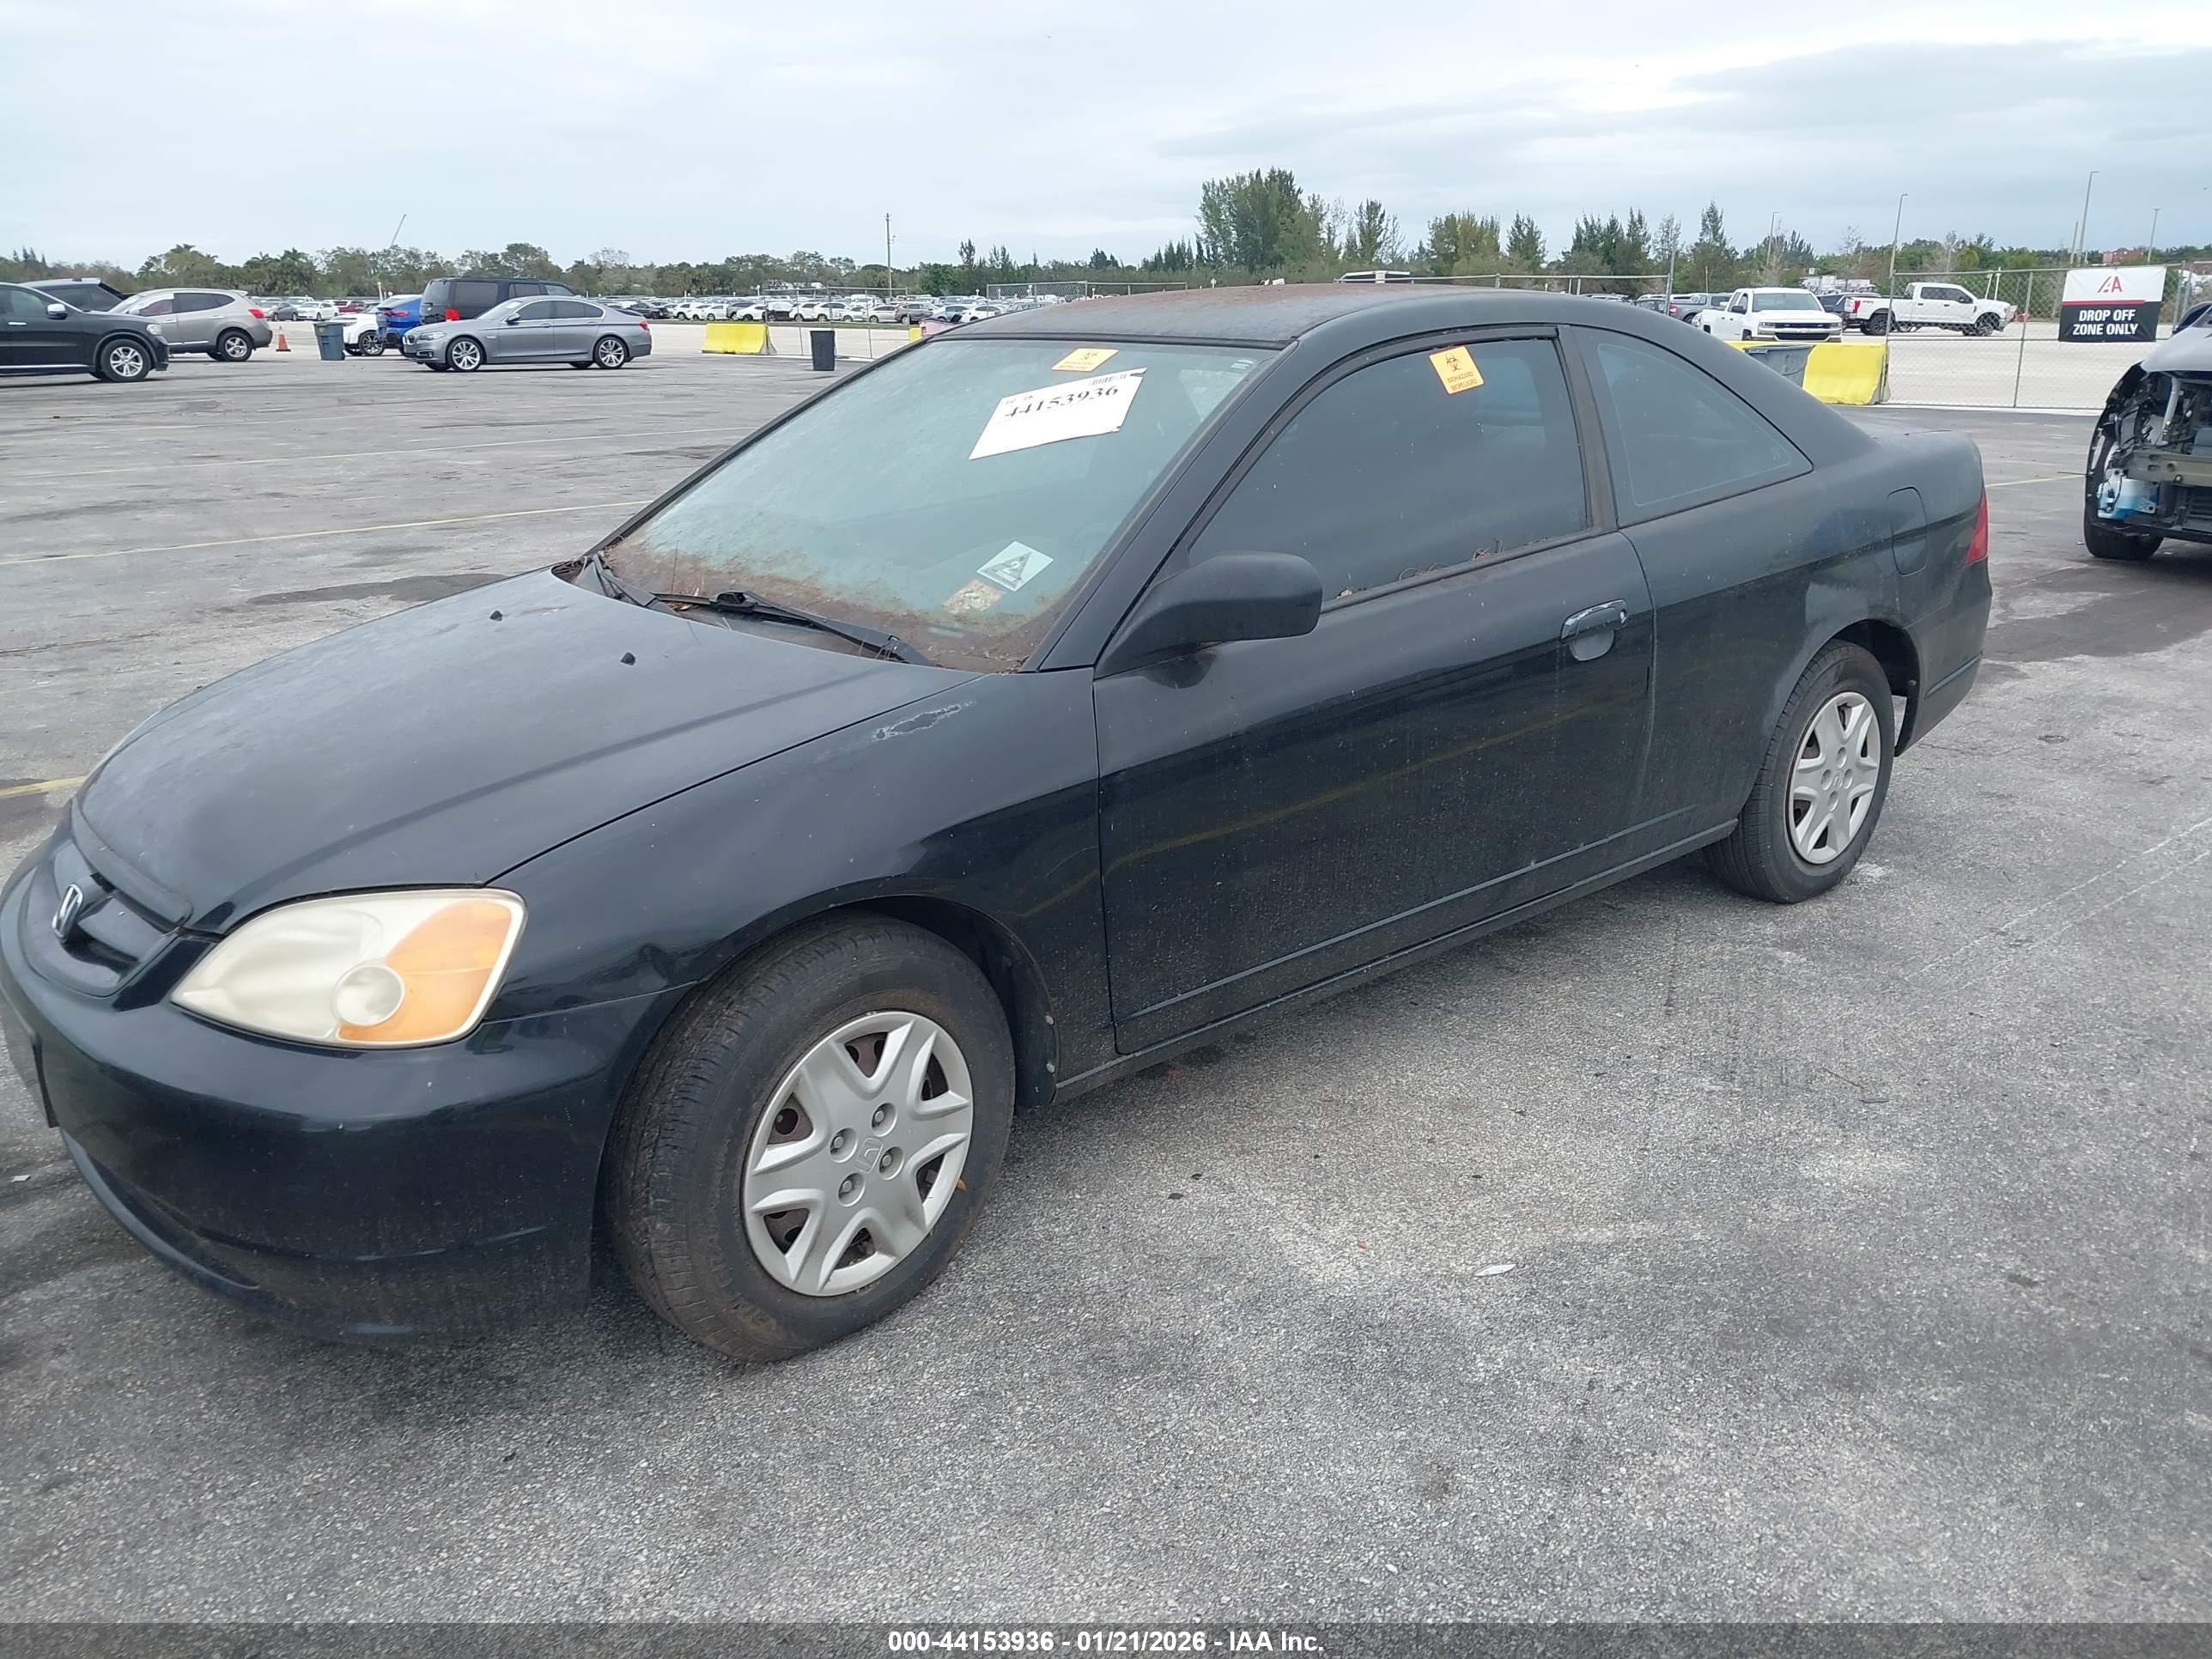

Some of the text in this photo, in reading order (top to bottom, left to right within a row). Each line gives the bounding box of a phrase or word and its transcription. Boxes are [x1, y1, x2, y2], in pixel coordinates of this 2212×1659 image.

[2079, 309, 2136, 322] DROP OFF
[2073, 323, 2139, 336] ZONE ONLY
[1004, 385, 1119, 417] 44153936
